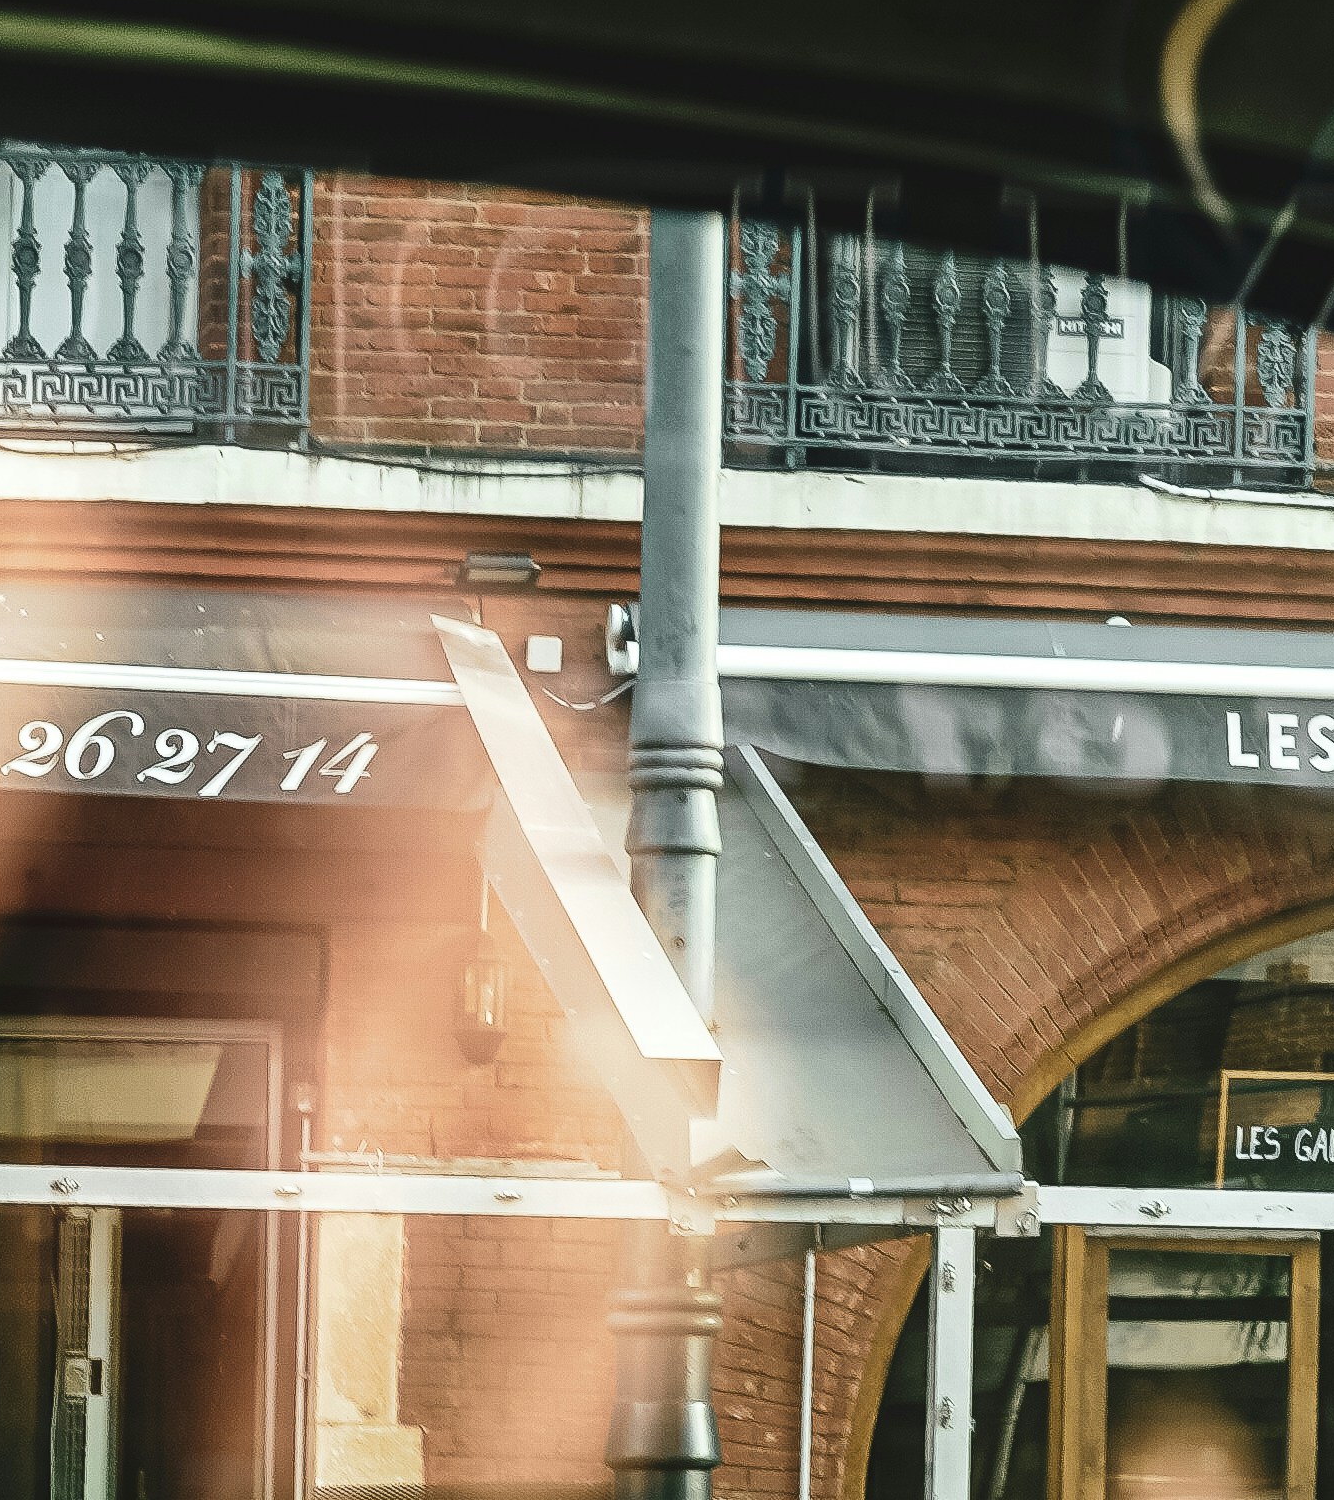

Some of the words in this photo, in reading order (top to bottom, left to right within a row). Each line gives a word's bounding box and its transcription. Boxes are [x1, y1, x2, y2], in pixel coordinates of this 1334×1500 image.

[1059, 320, 1124, 336] HITHI
[0, 710, 146, 781] 26
[136, 727, 263, 798] 27
[279, 731, 380, 795] 14
[1235, 1125, 1281, 1160] LES
